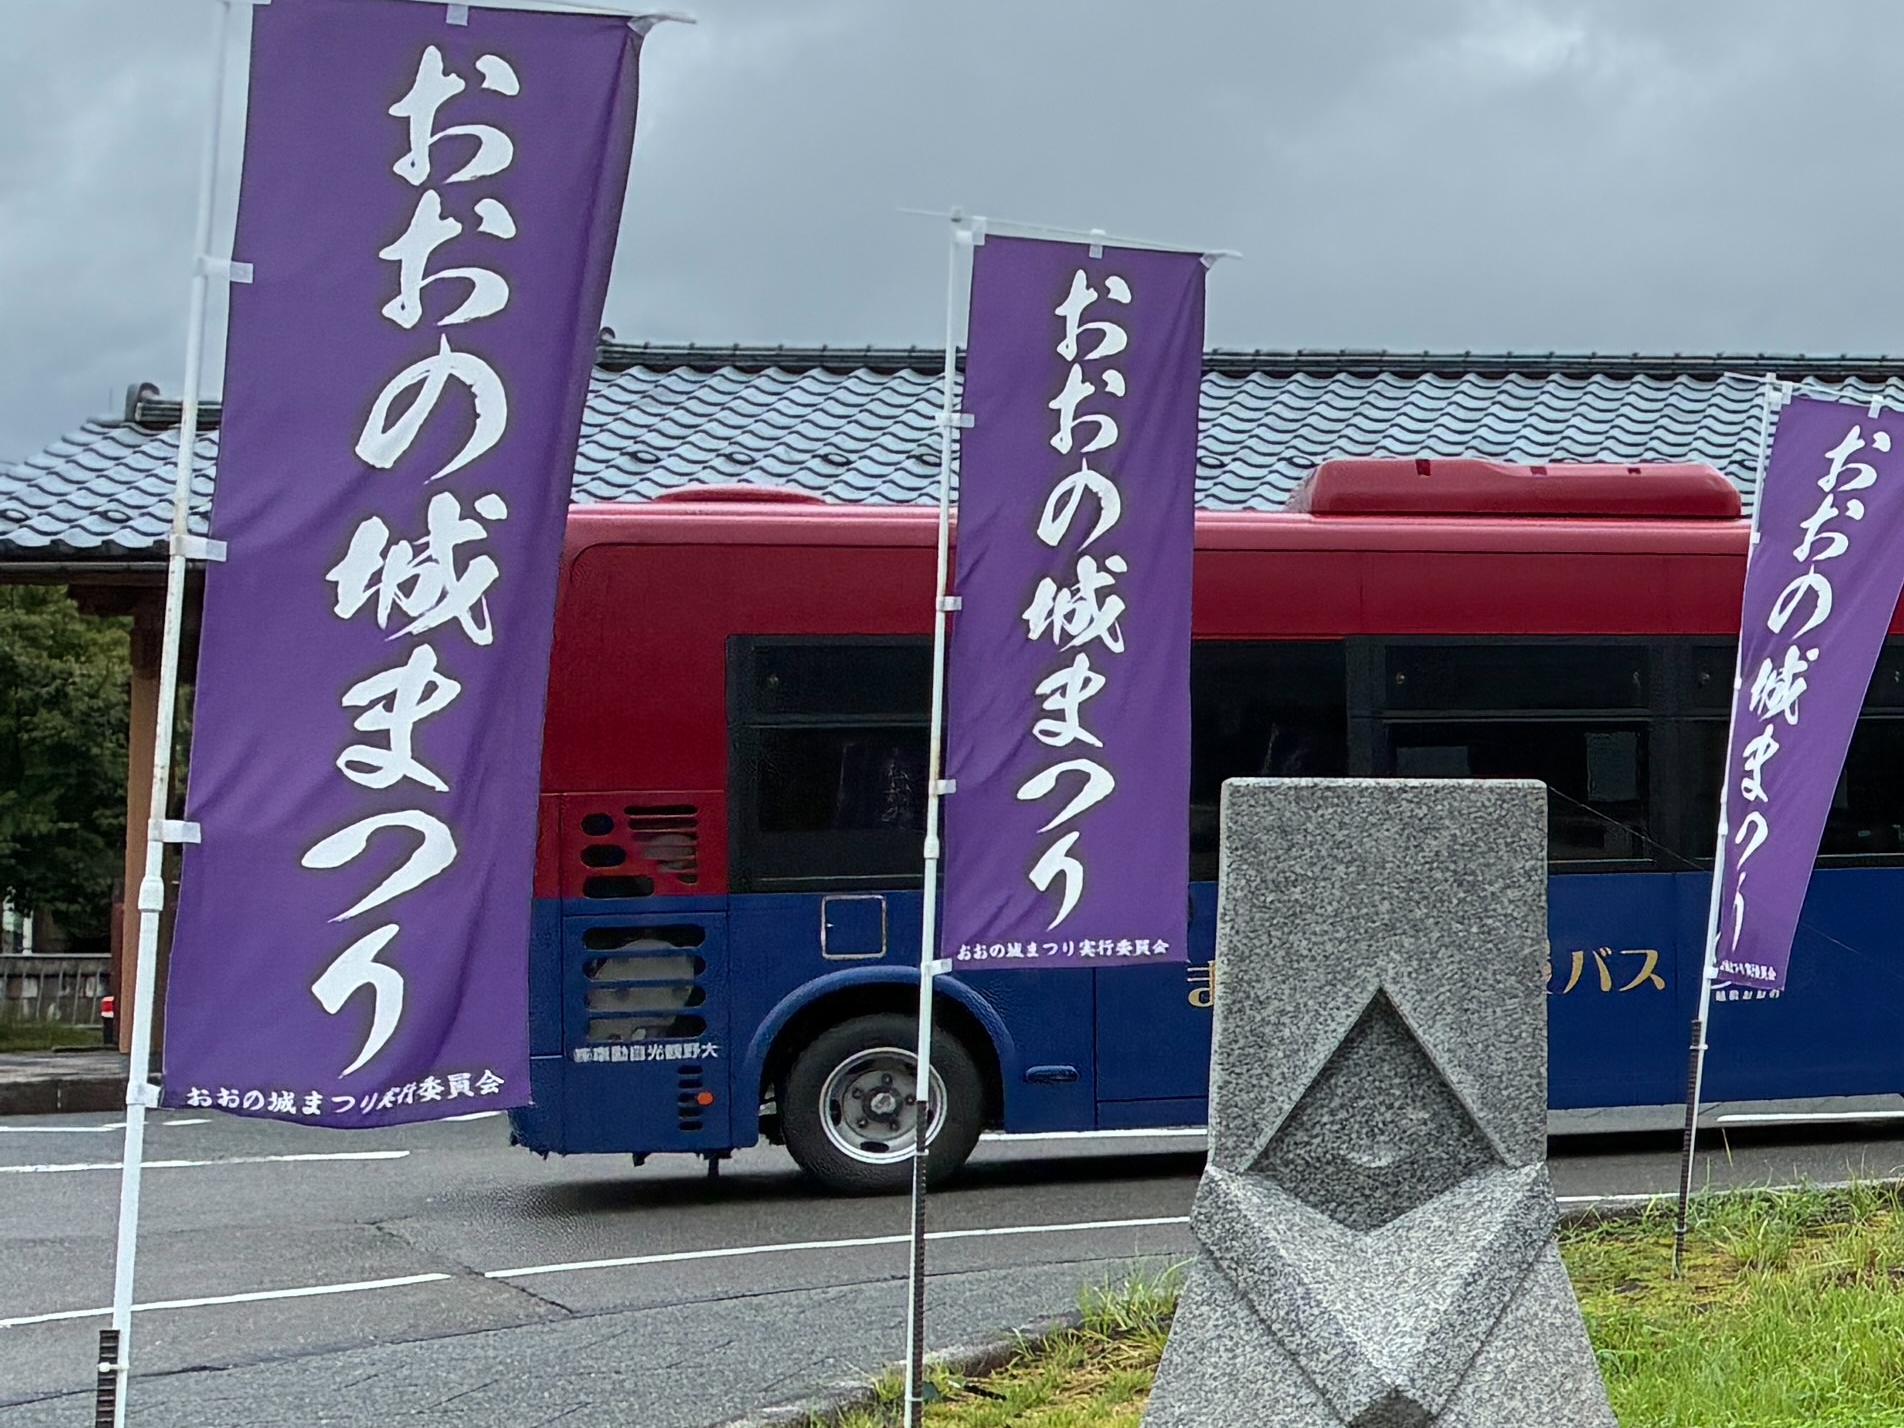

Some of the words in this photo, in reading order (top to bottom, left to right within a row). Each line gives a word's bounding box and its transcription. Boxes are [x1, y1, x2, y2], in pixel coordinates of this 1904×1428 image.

[302, 46, 519, 1079] おおの城まつり
[1017, 269, 1132, 931] おおの城まつり
[1731, 426, 1891, 952] おおの城まつり
[957, 938, 1170, 961] おおの城まつり実行委員会
[1543, 946, 1666, 995] バス
